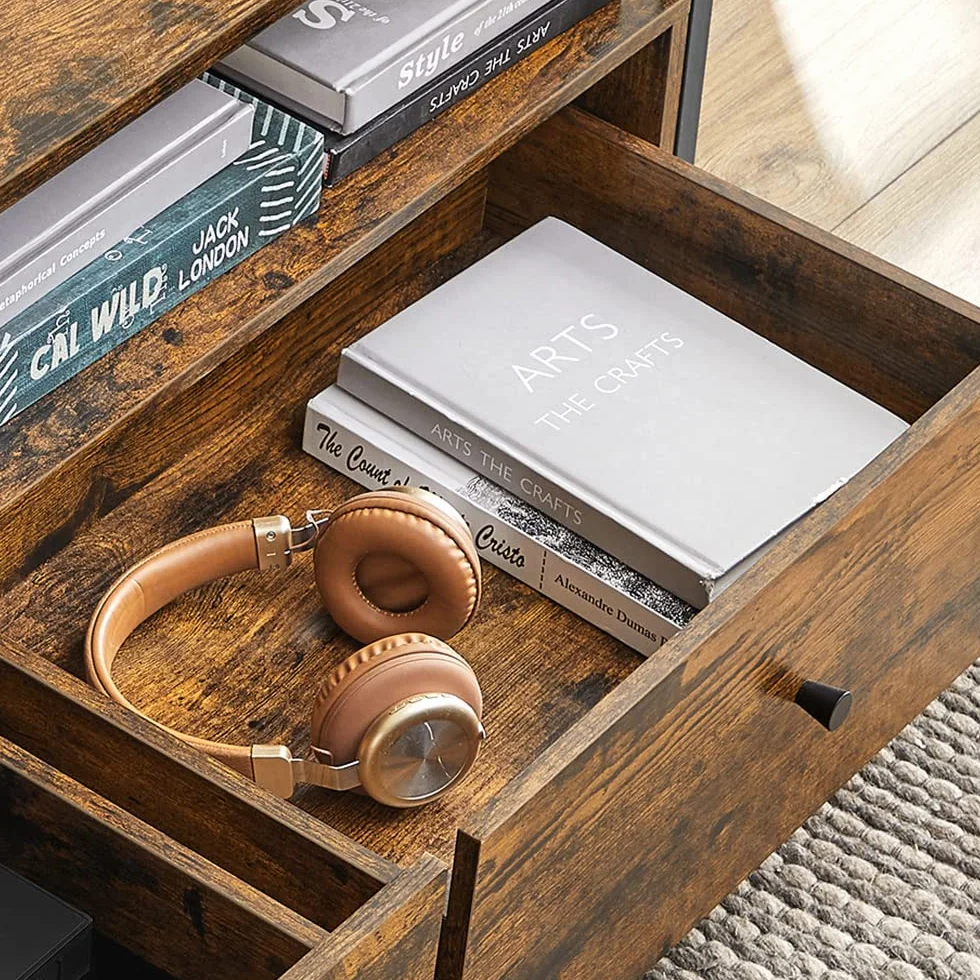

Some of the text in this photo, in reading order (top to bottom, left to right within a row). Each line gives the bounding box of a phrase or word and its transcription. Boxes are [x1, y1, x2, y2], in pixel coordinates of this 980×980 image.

[398, 31, 465, 90] Style
[429, 22, 551, 112] ARTS THE CRAFTS
[59, 228, 106, 267] Concepts
[178, 226, 250, 291] LONDON
[192, 207, 239, 255] JACK
[30, 264, 163, 380] CAL WILD
[511, 313, 619, 393] ARTS
[534, 331, 684, 431] THE CRAFTS
[316, 423, 526, 568] The Count Cristo
[431, 424, 584, 525] ARTS THE CRAFTS
[554, 573, 615, 616] Alexandre
[616, 609, 657, 643] Dumas
